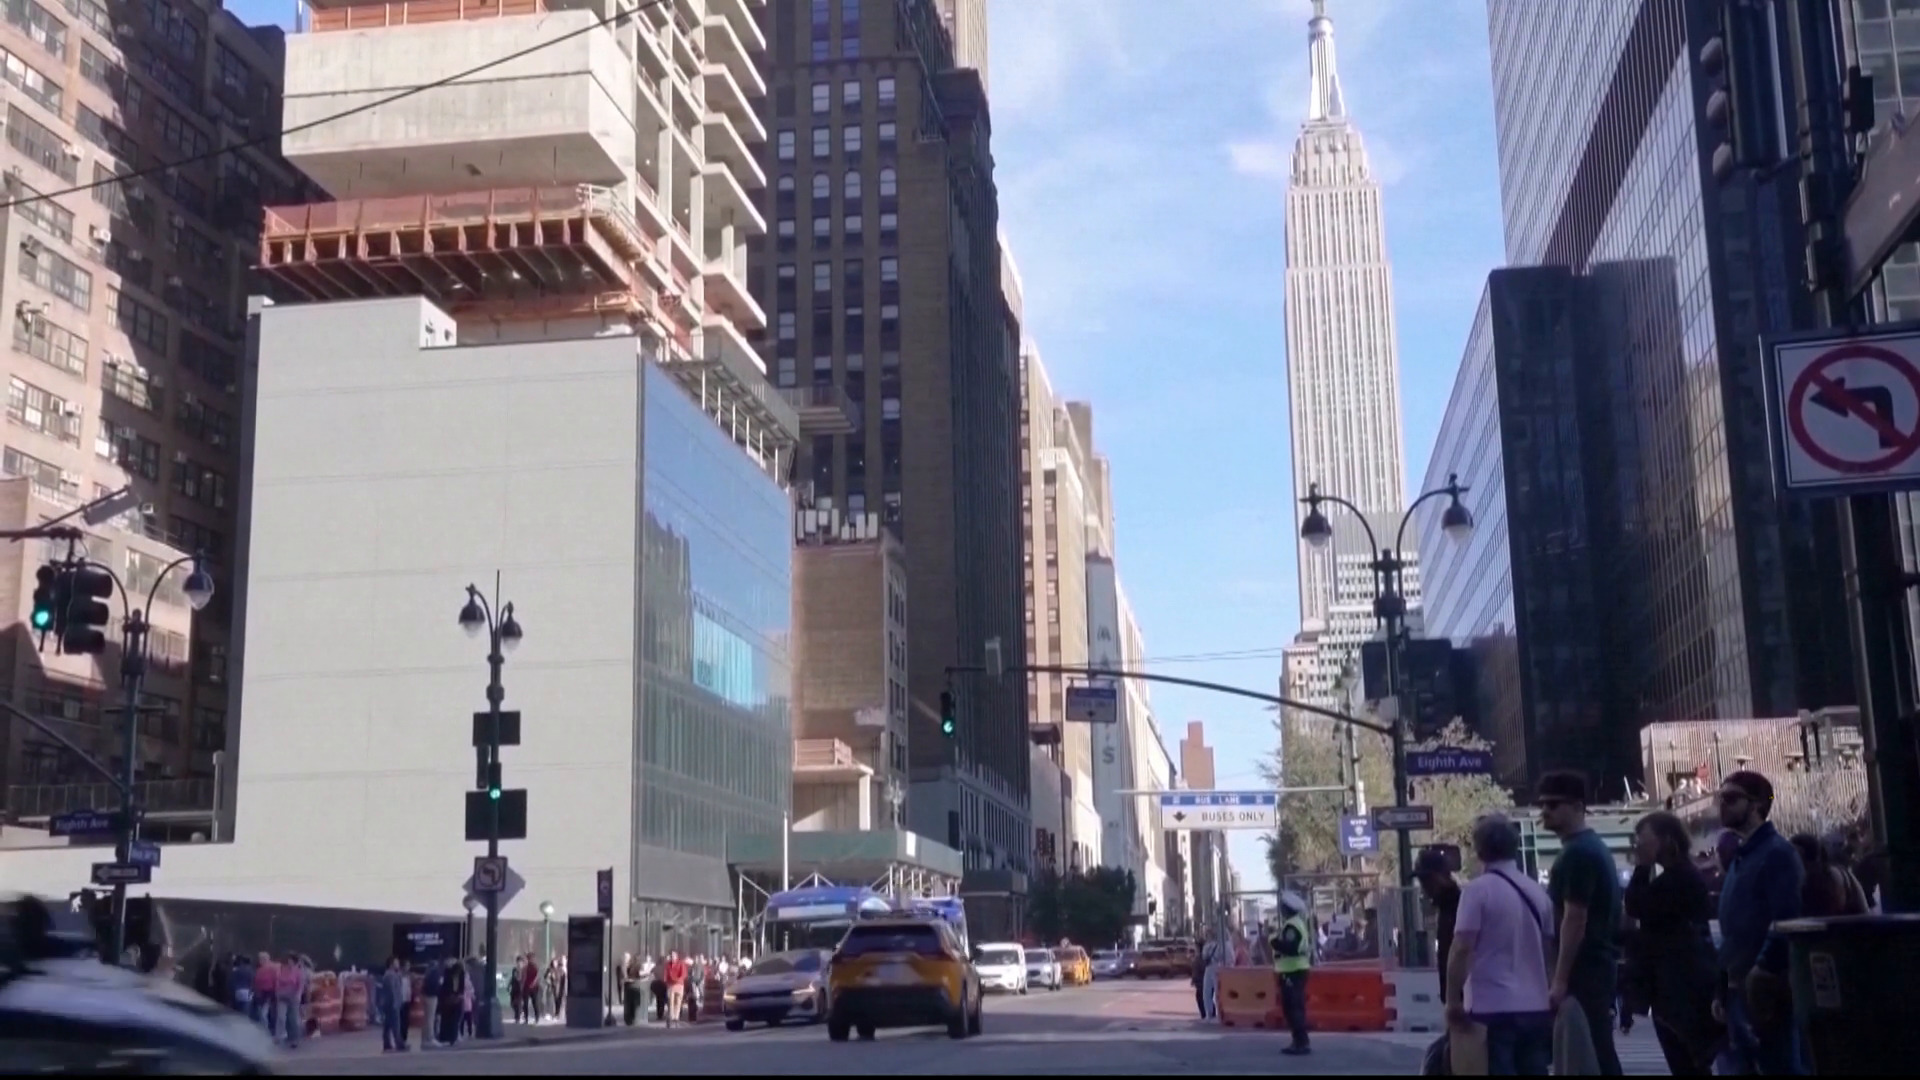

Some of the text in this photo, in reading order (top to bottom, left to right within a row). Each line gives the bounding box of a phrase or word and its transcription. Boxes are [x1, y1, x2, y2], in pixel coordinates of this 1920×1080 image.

[1417, 757, 1482, 769] Eighth Ave
[1195, 795, 1240, 804] BUS LANE
[1201, 811, 1265, 822] BUSES ONLY
[55, 818, 109, 832] Eighth Ave
